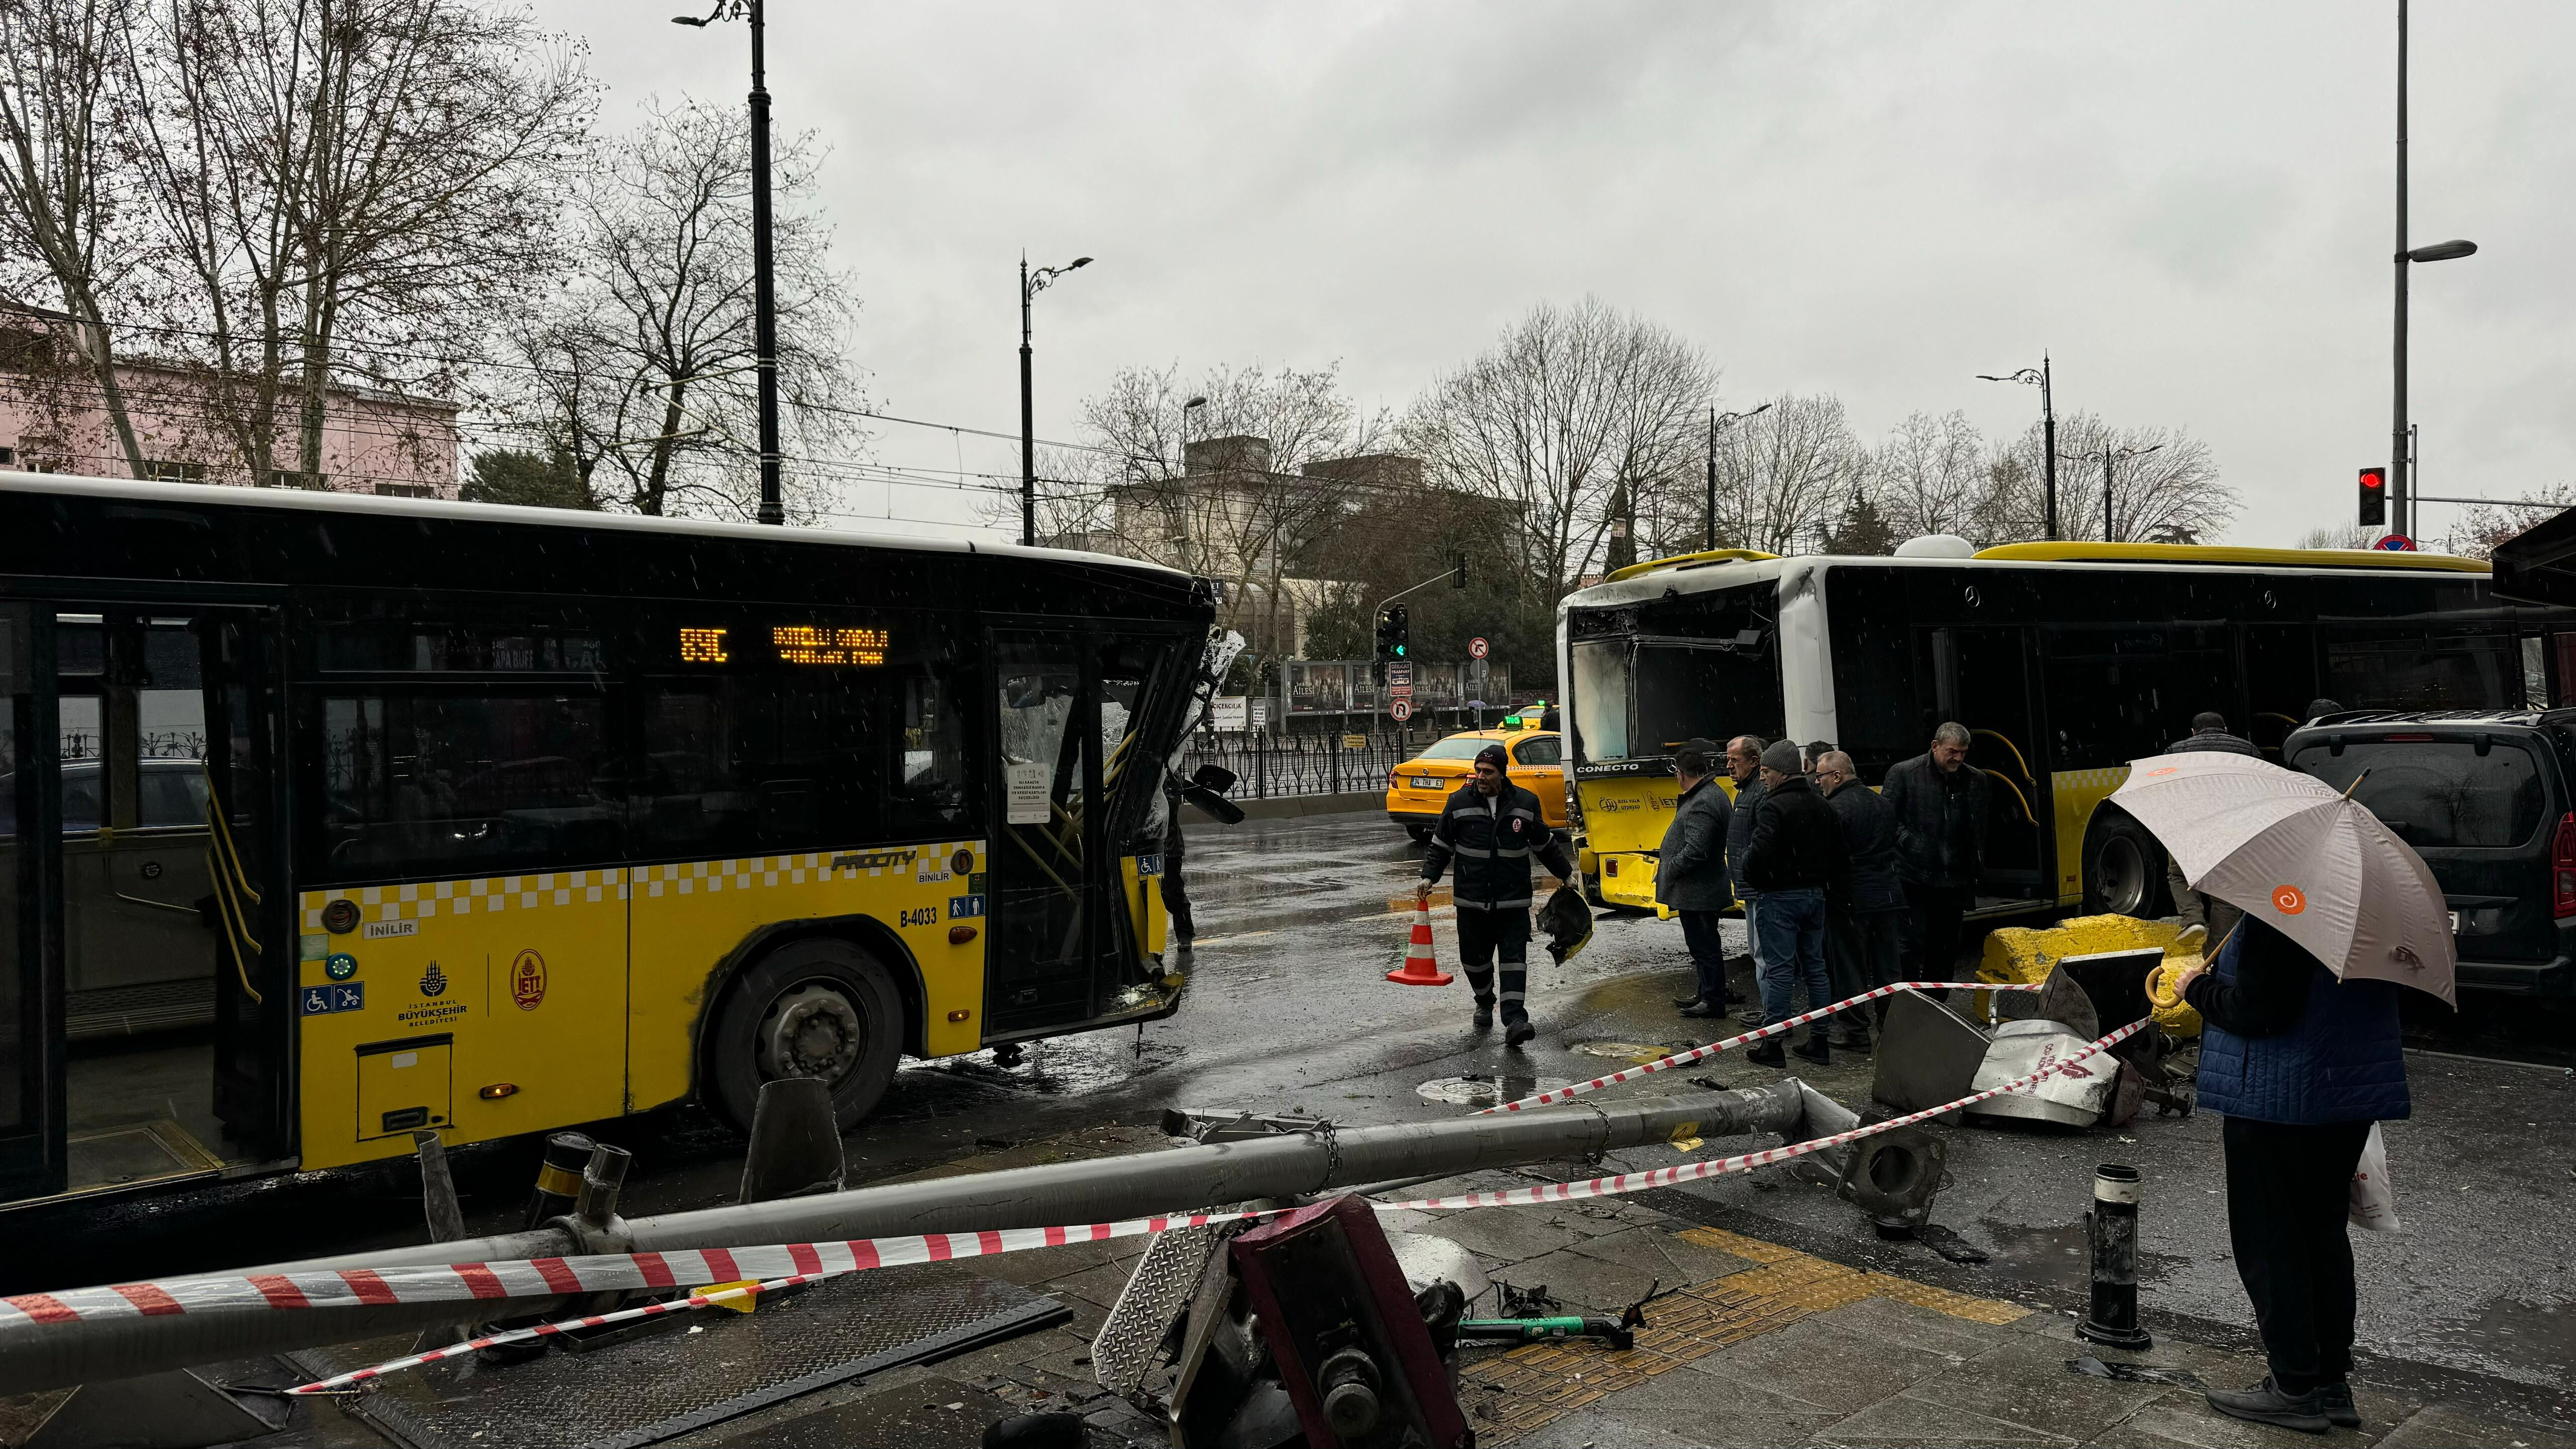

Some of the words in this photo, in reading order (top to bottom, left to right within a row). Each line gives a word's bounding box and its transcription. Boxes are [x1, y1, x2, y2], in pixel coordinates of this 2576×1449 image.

[1577, 764, 1639, 773] CONECTO
[832, 850, 916, 871] PROCITY
[919, 872, 949, 882] BİNİLİR
[901, 907, 937, 928] B-4033
[370, 923, 413, 936] İNİLİR
[410, 1000, 457, 1009] İSTANBUL
[398, 1005, 467, 1021] BÜYÜKŞEHİR
[409, 1016, 457, 1027] BELEDİYESİ
